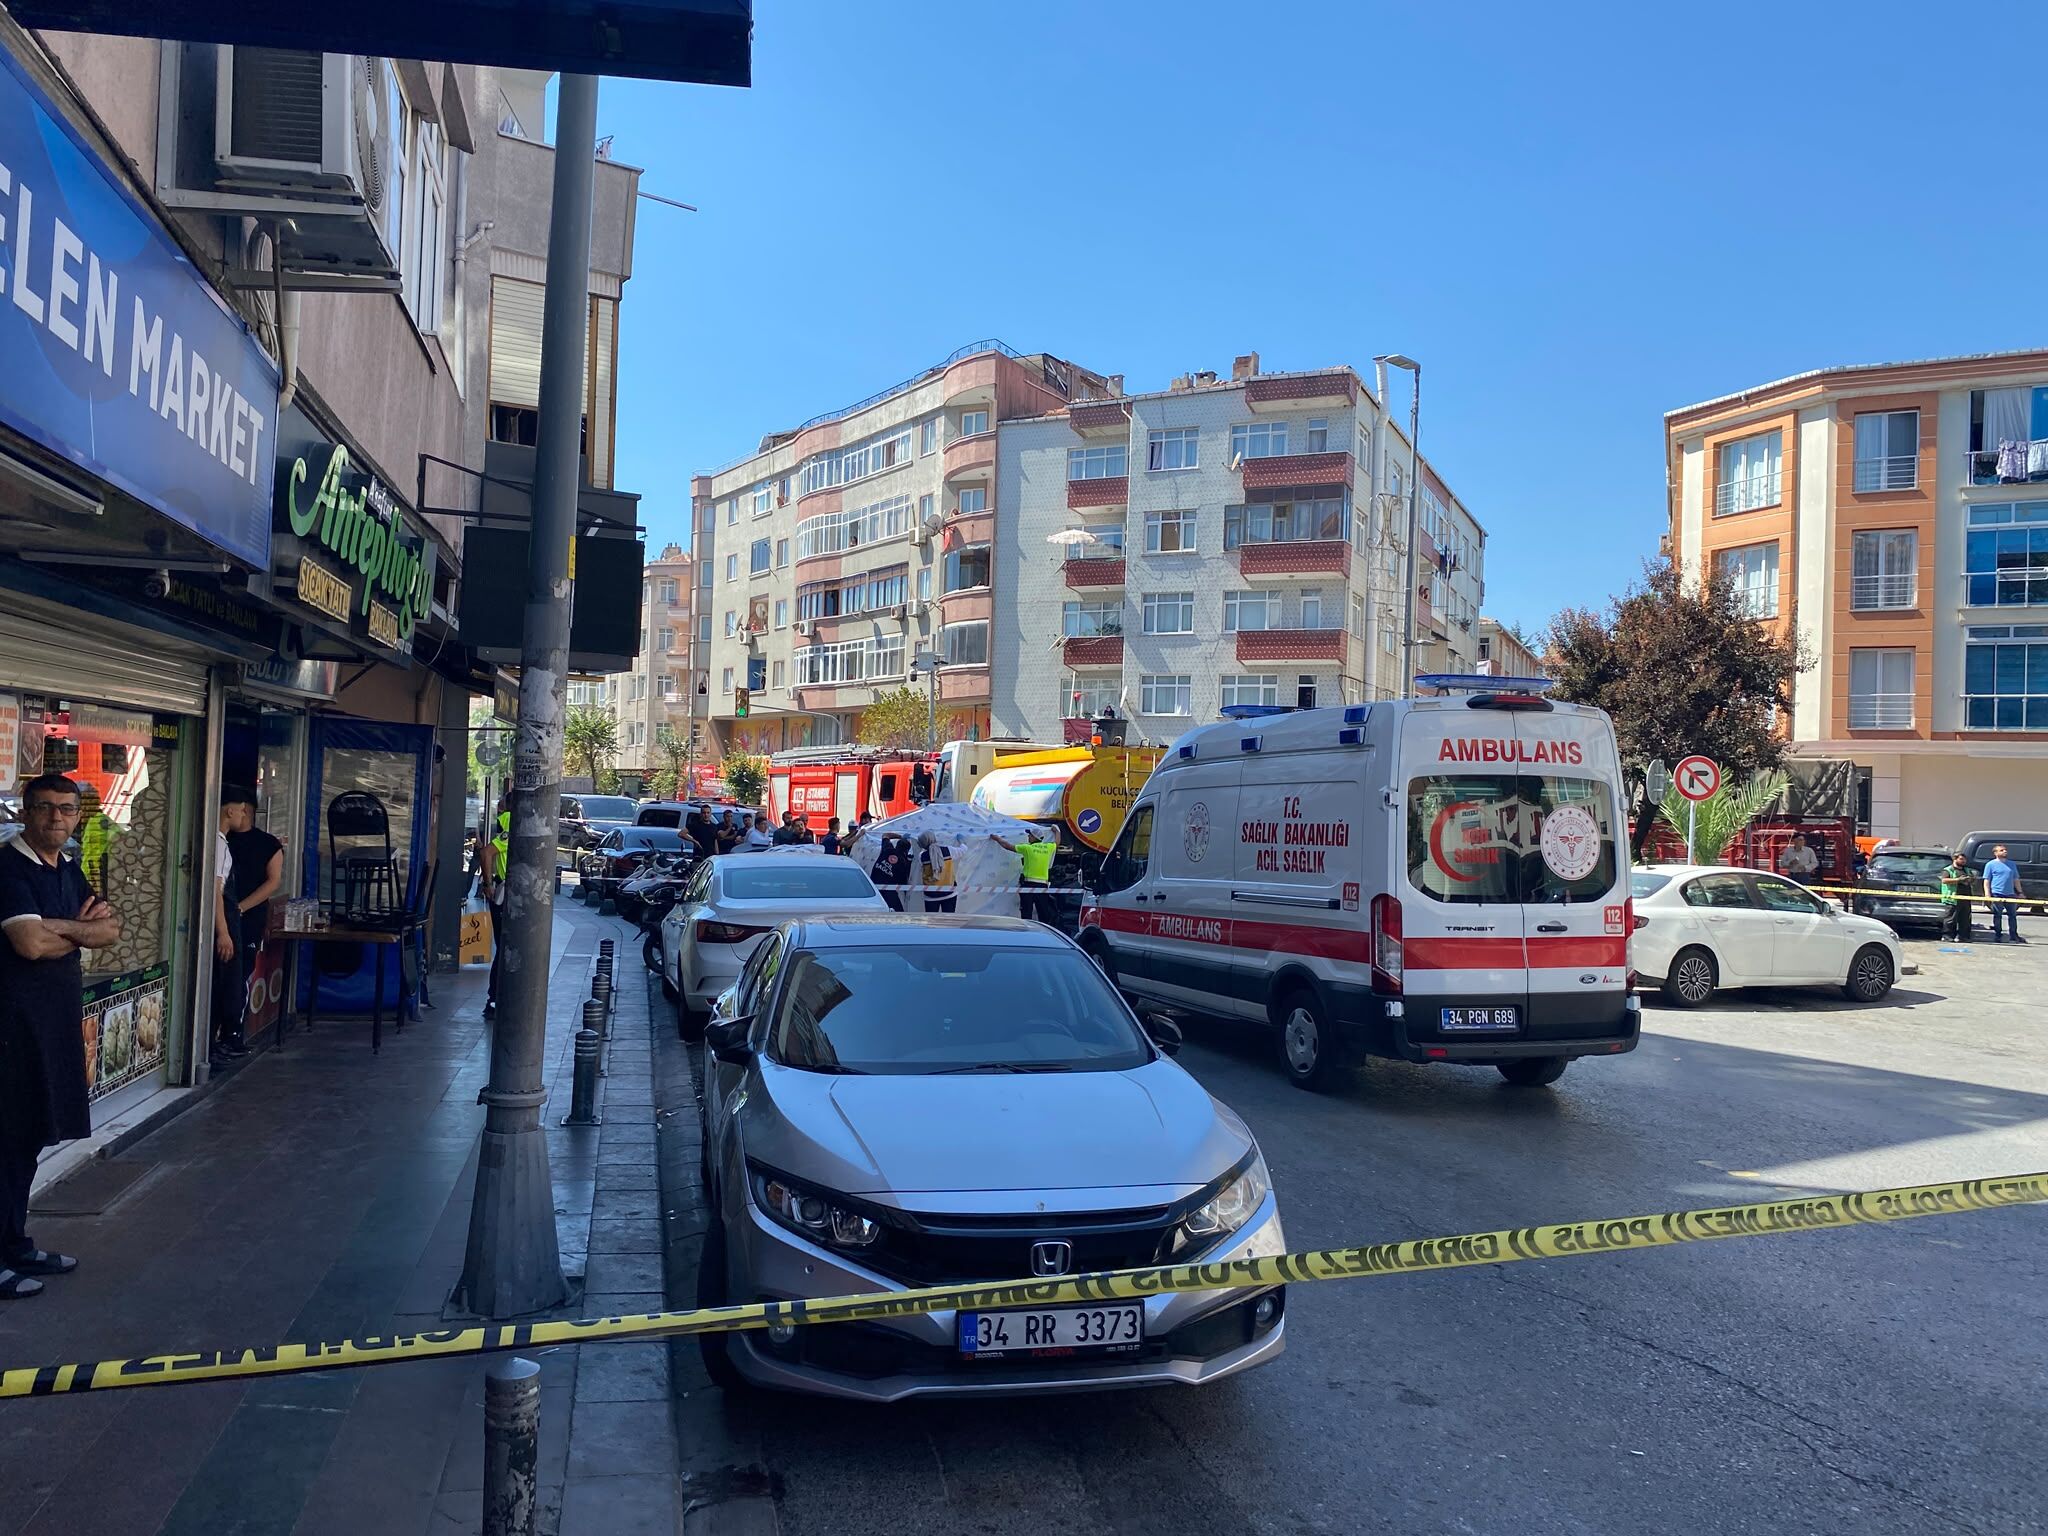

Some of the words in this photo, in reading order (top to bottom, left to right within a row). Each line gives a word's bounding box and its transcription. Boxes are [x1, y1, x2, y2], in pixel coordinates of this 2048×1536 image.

[129, 295, 264, 486] MARKET
[1439, 739, 1583, 765] AMBULANS
[1284, 797, 1302, 819] T.C.
[1241, 819, 1278, 845] SAĞLIK
[1284, 818, 1349, 847] BAKANLIĞI
[1257, 846, 1280, 872] ACİL
[1283, 847, 1326, 873] SAĞLIK
[1344, 886, 1357, 900] 112
[1606, 908, 1621, 923] 112
[1159, 917, 1222, 942] AMBULANS
[1449, 1010, 1463, 1024] 34
[1468, 1010, 1488, 1024] PGN
[1494, 1009, 1514, 1024] 689
[964, 1336, 976, 1345] TR
[978, 1317, 1009, 1347] 34
[1025, 1315, 1056, 1345] RR
[1075, 1310, 1138, 1342] 3373
